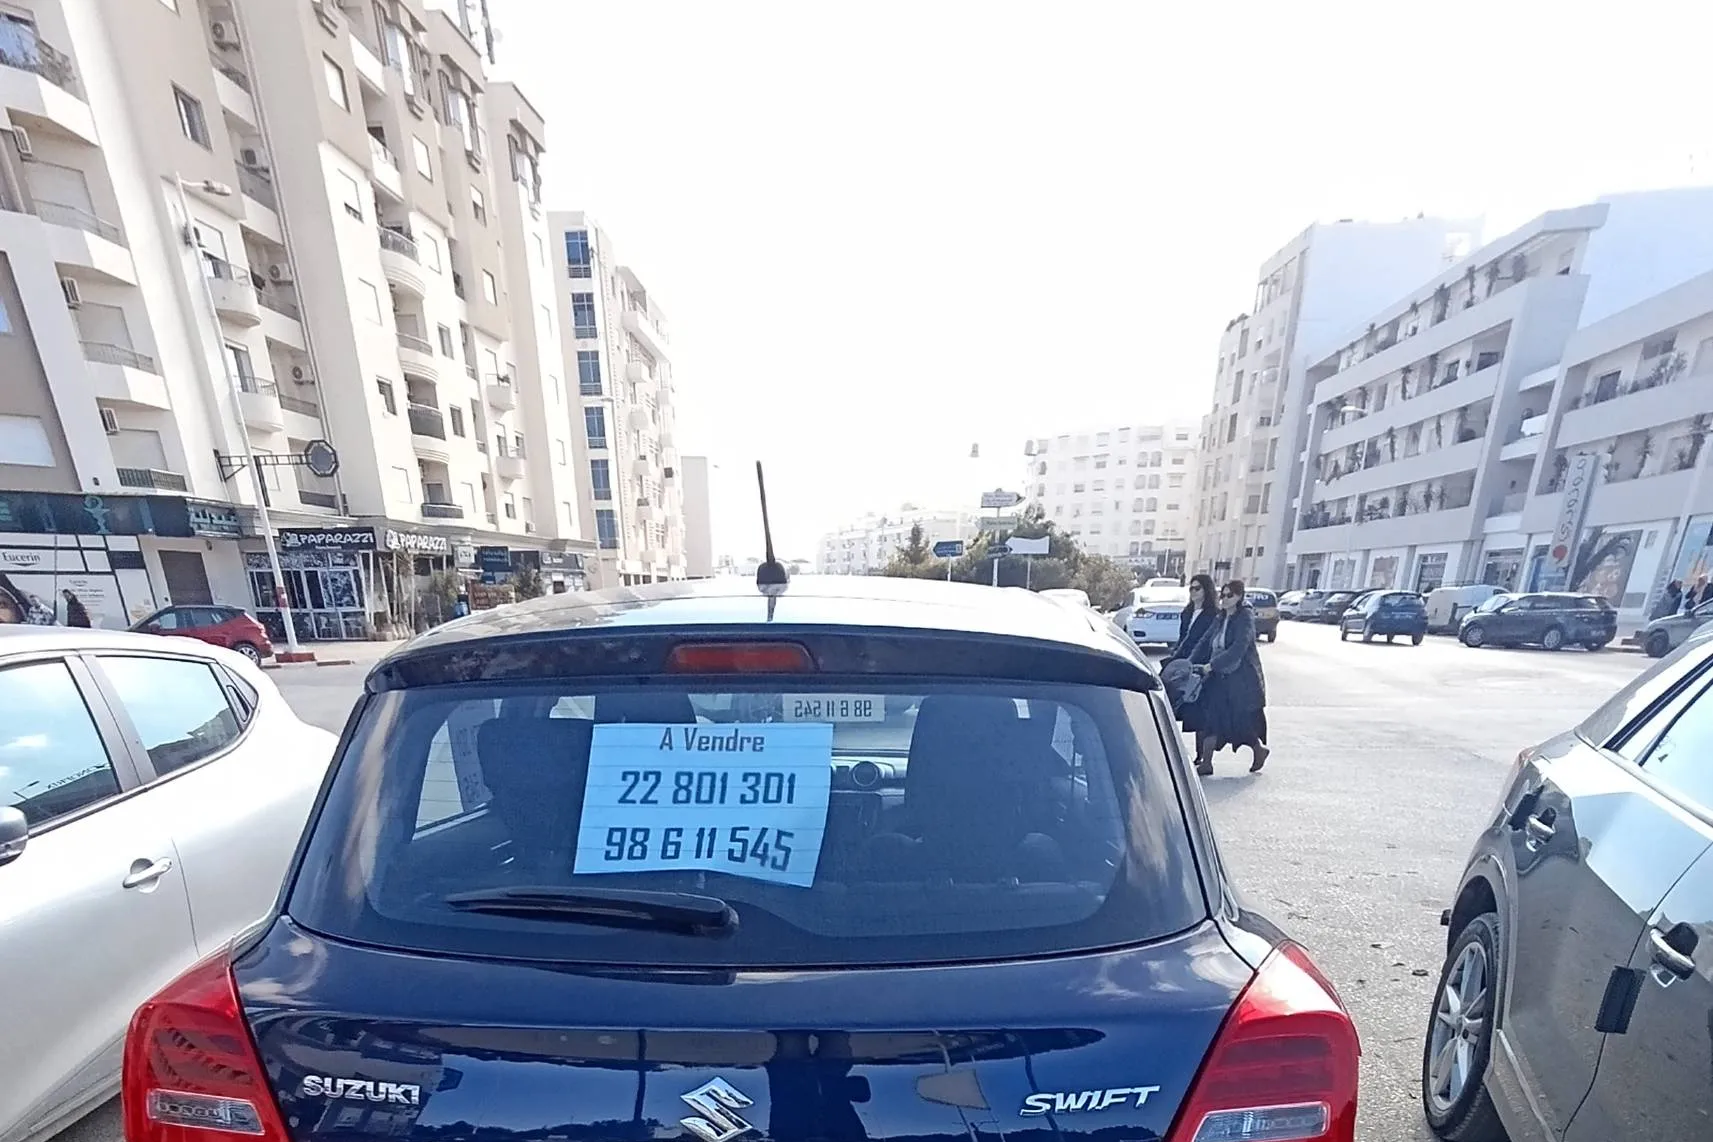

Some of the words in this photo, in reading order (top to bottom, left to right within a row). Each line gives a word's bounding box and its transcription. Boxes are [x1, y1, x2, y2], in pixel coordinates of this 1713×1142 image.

[299, 532, 374, 544] PAPARAZZI
[399, 532, 448, 551] PAPARAZZI
[2, 551, 41, 562] Eucerin
[659, 727, 674, 751] A
[684, 727, 765, 753] Vendre
[617, 770, 663, 805] 22
[672, 771, 729, 805] 801
[739, 772, 797, 805] 301
[604, 827, 650, 861] 98
[660, 827, 683, 860] 6
[695, 827, 715, 860] 11
[727, 826, 795, 872] 545
[302, 1074, 421, 1105] SUZUKI
[1019, 1085, 1161, 1117] SWIFT
